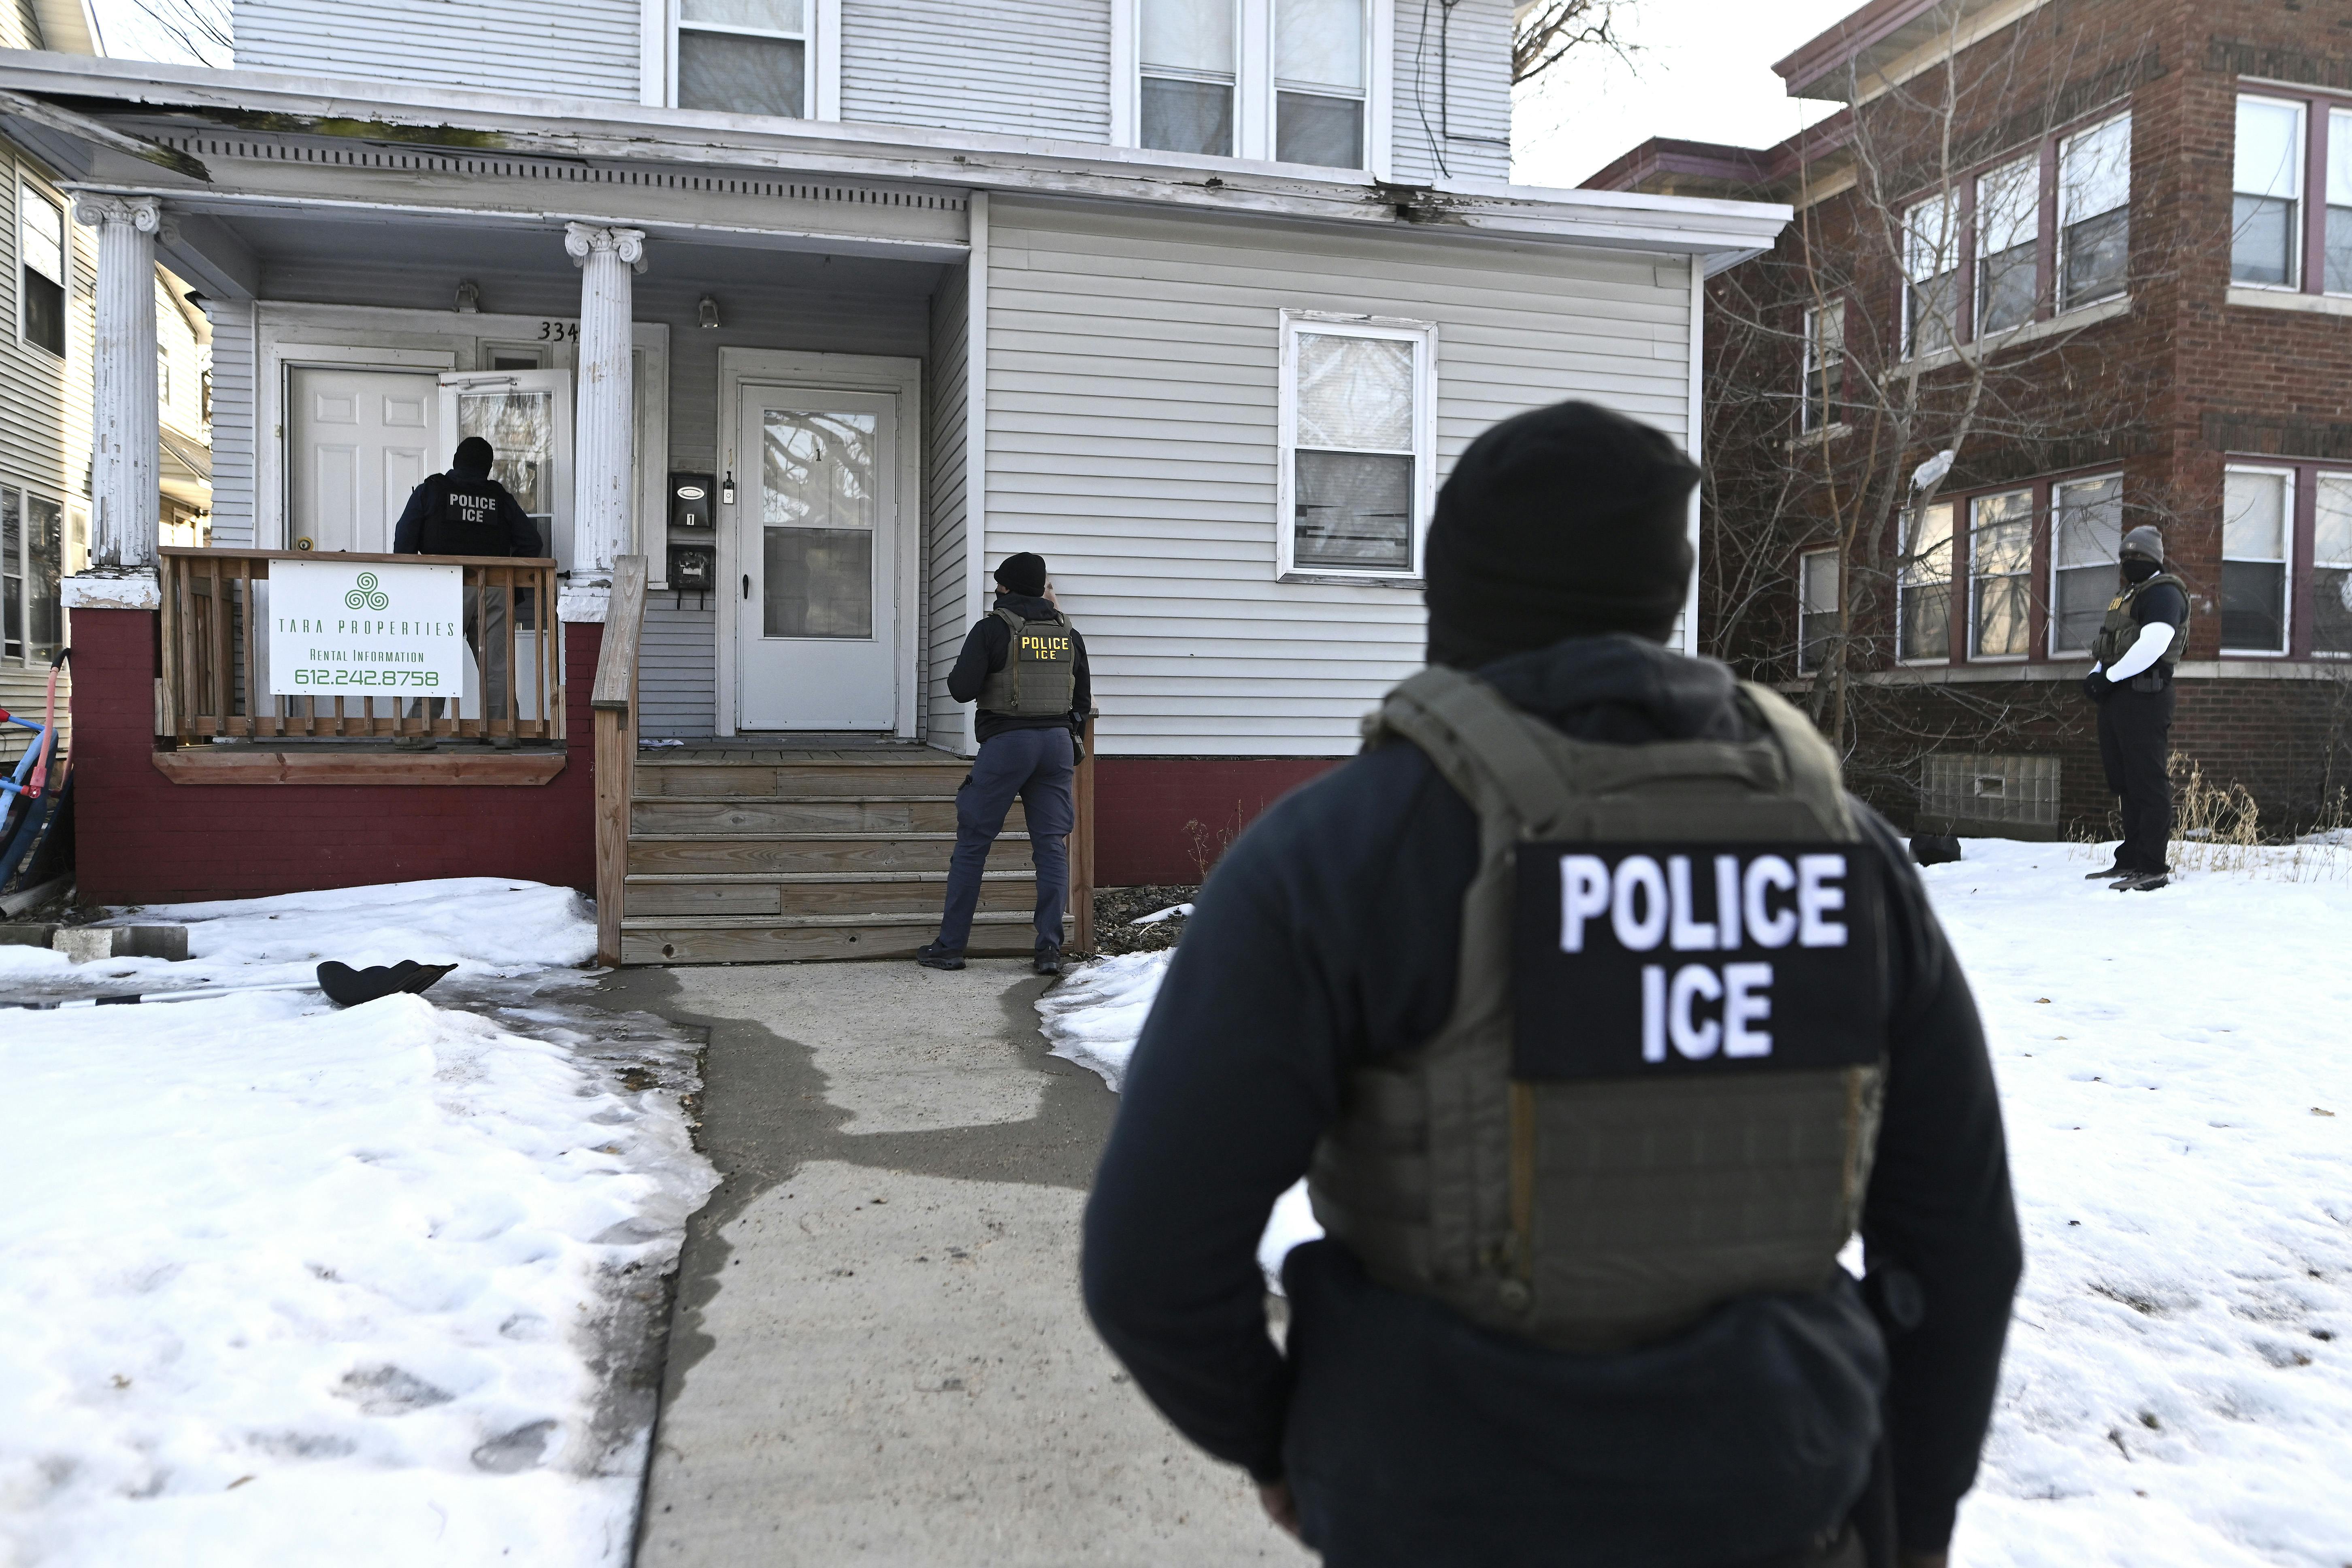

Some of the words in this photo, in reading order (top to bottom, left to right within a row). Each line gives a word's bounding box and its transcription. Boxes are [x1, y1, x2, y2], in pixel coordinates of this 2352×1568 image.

[538, 322, 580, 343] 334
[816, 449, 822, 462] 1
[450, 494, 496, 511] POLICE
[462, 508, 483, 523] ICE
[689, 515, 692, 525] 1
[279, 619, 322, 633] TARA
[339, 620, 453, 636] PROPERTIES
[1022, 637, 1069, 650] POLICE
[1036, 650, 1056, 660] ICE
[295, 669, 438, 686] 612.242.8758
[1559, 854, 1848, 953] POLICE
[1642, 962, 1773, 1063] ICE
